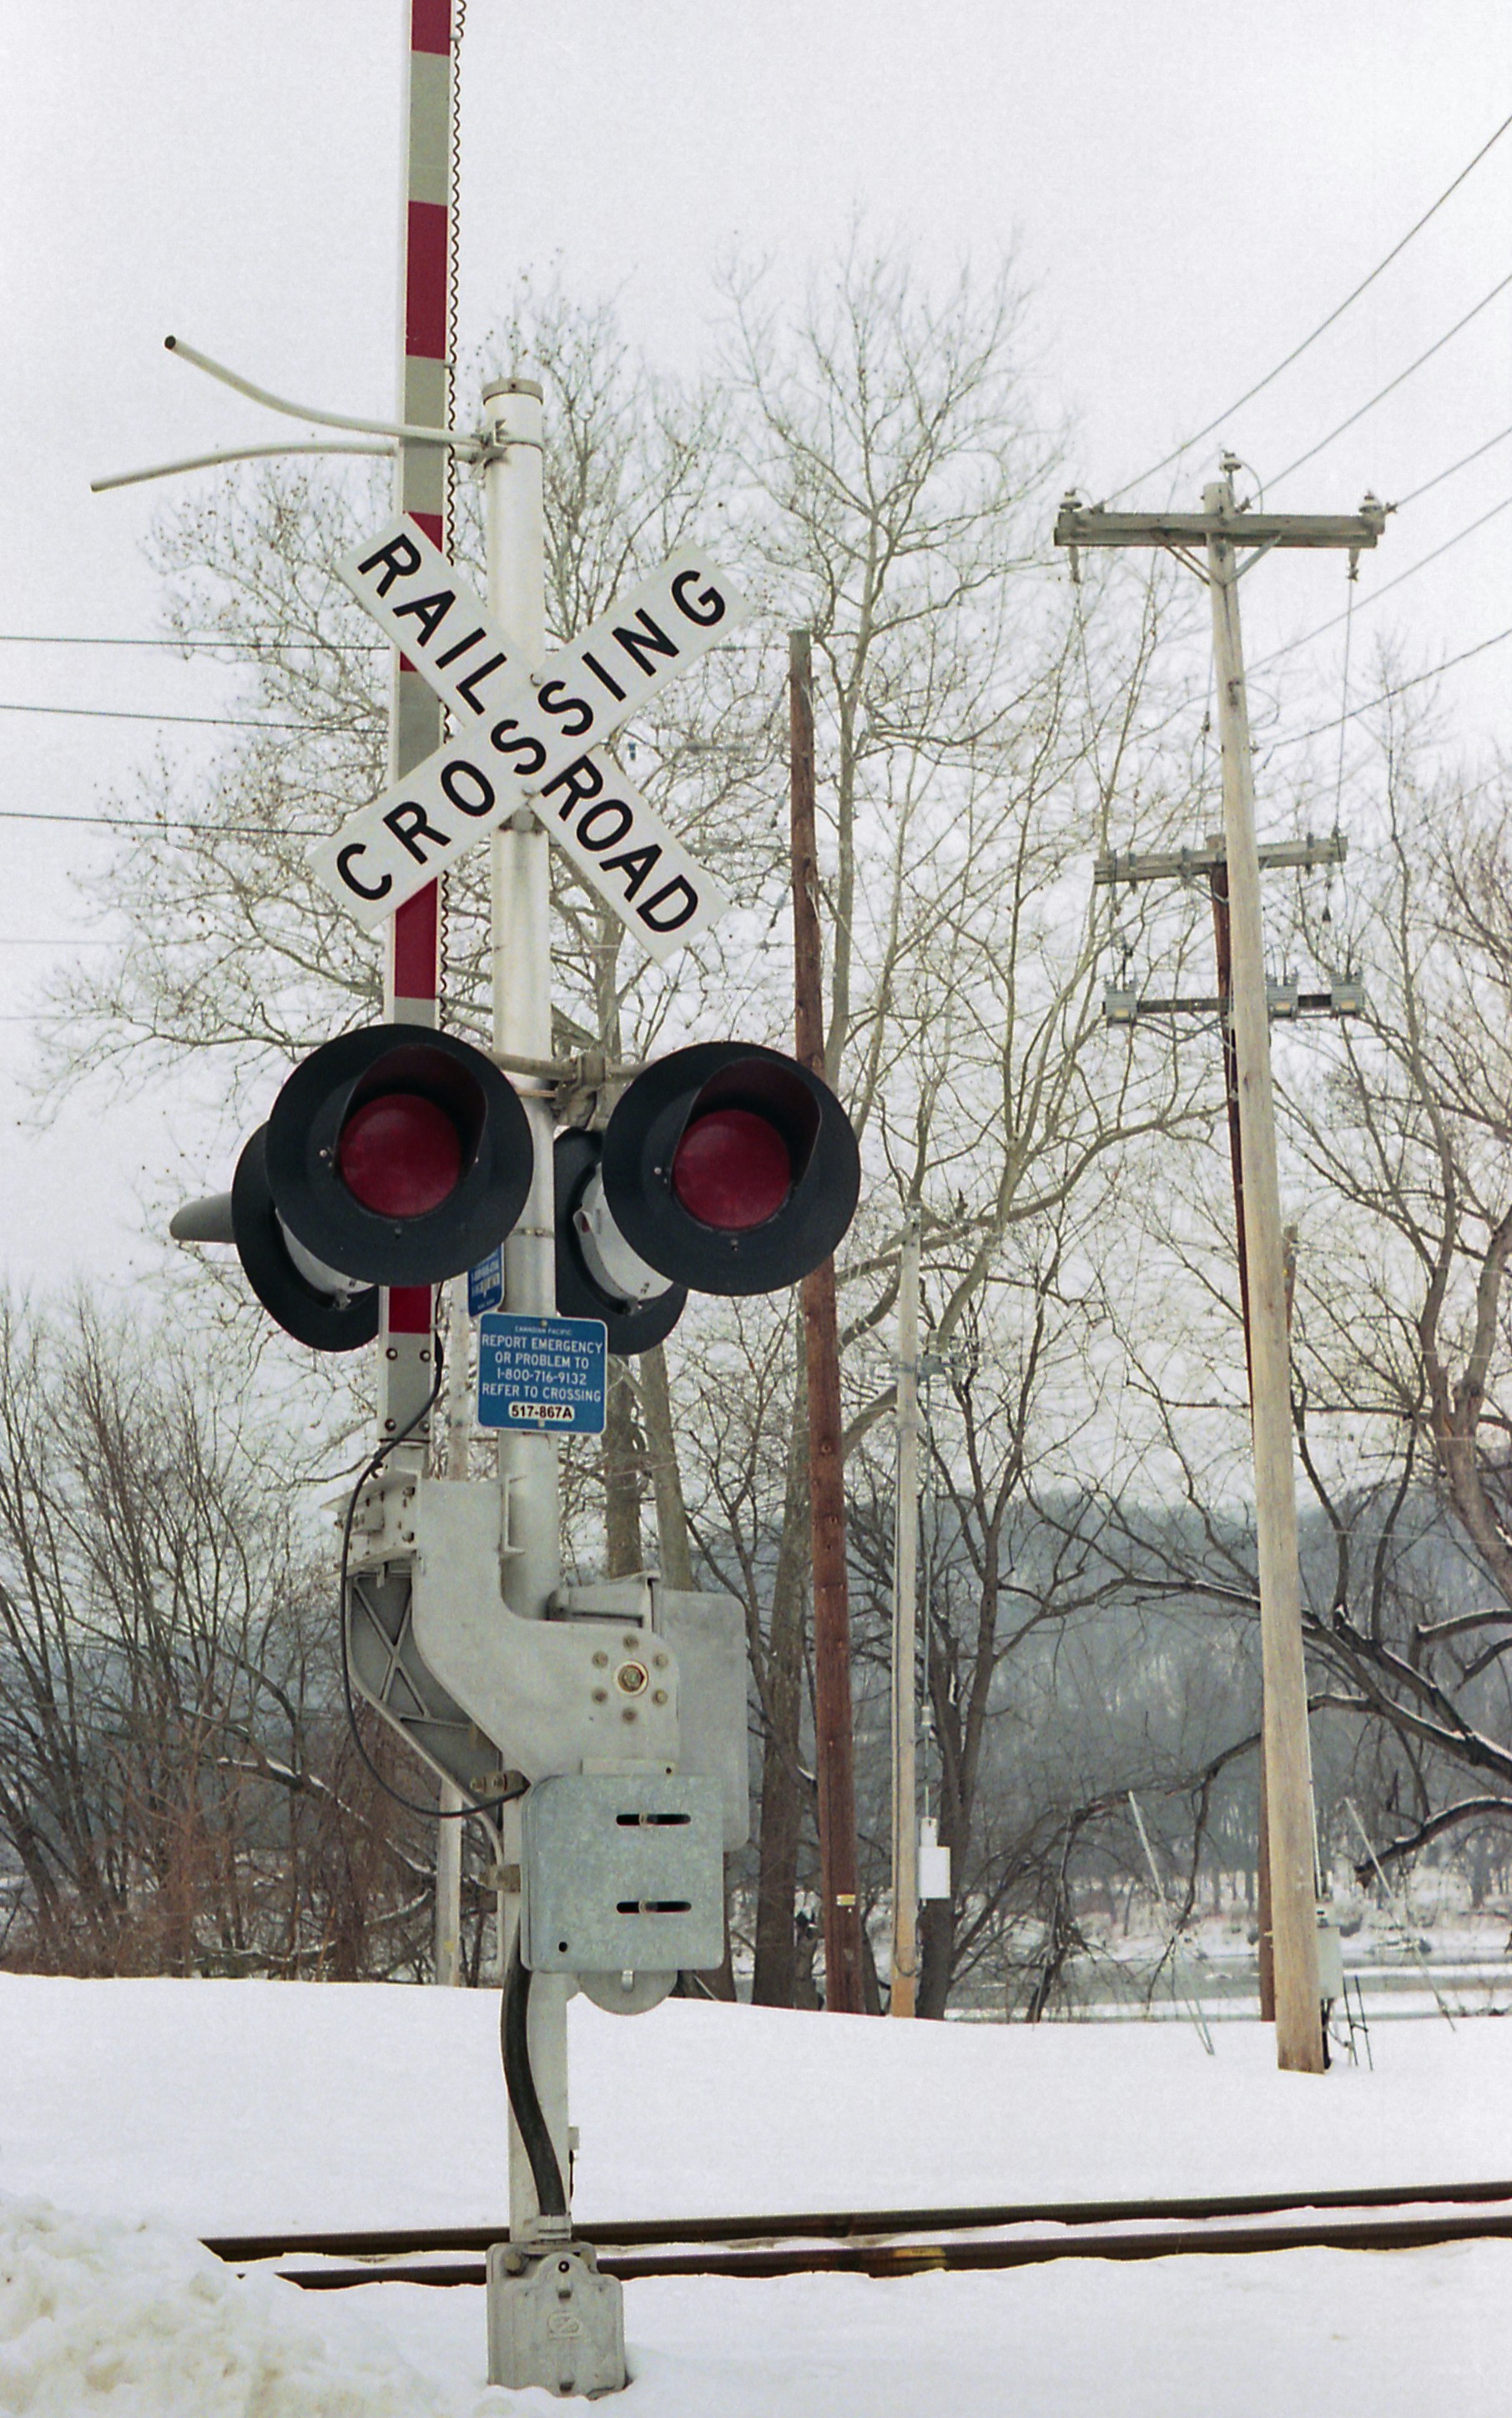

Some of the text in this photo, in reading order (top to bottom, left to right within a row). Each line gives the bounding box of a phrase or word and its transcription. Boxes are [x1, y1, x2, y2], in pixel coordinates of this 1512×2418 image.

[335, 569, 726, 901] CROSSING
[357, 532, 699, 933] RAIL ROAD
[515, 1325, 547, 1333] CANADIAN
[482, 1334, 602, 1354] REPORT EMERGENCY
[495, 1351, 589, 1368] OR PROBLEM TO
[497, 1368, 587, 1385] 1-800-716-9132
[482, 1383, 601, 1402] REFER TO CROSSING
[512, 1405, 572, 1419] 517-867A
